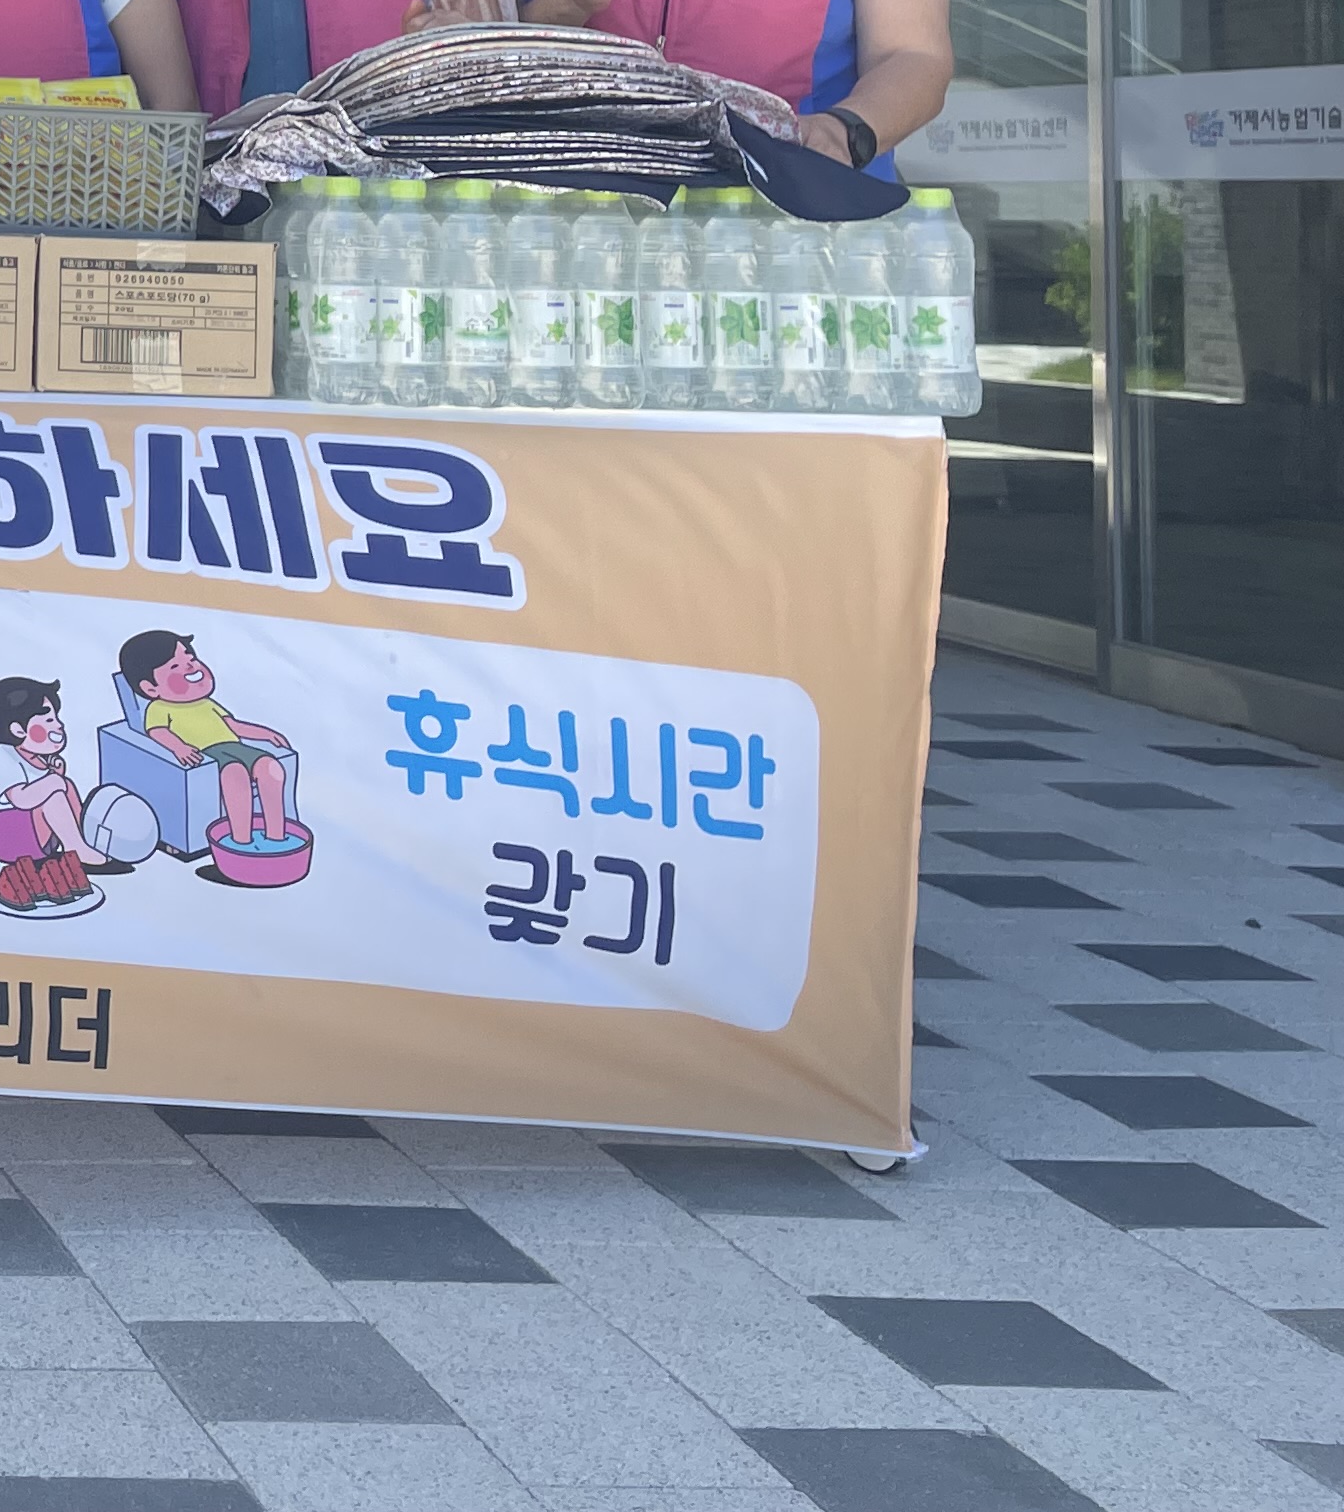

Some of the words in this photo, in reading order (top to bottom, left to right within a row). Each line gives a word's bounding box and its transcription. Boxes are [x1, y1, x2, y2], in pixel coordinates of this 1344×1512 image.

[115, 273, 185, 285] 926940050
[199, 292, 211, 304] g)
[384, 687, 777, 841] 휴식시간
[483, 840, 677, 966] 갖기
